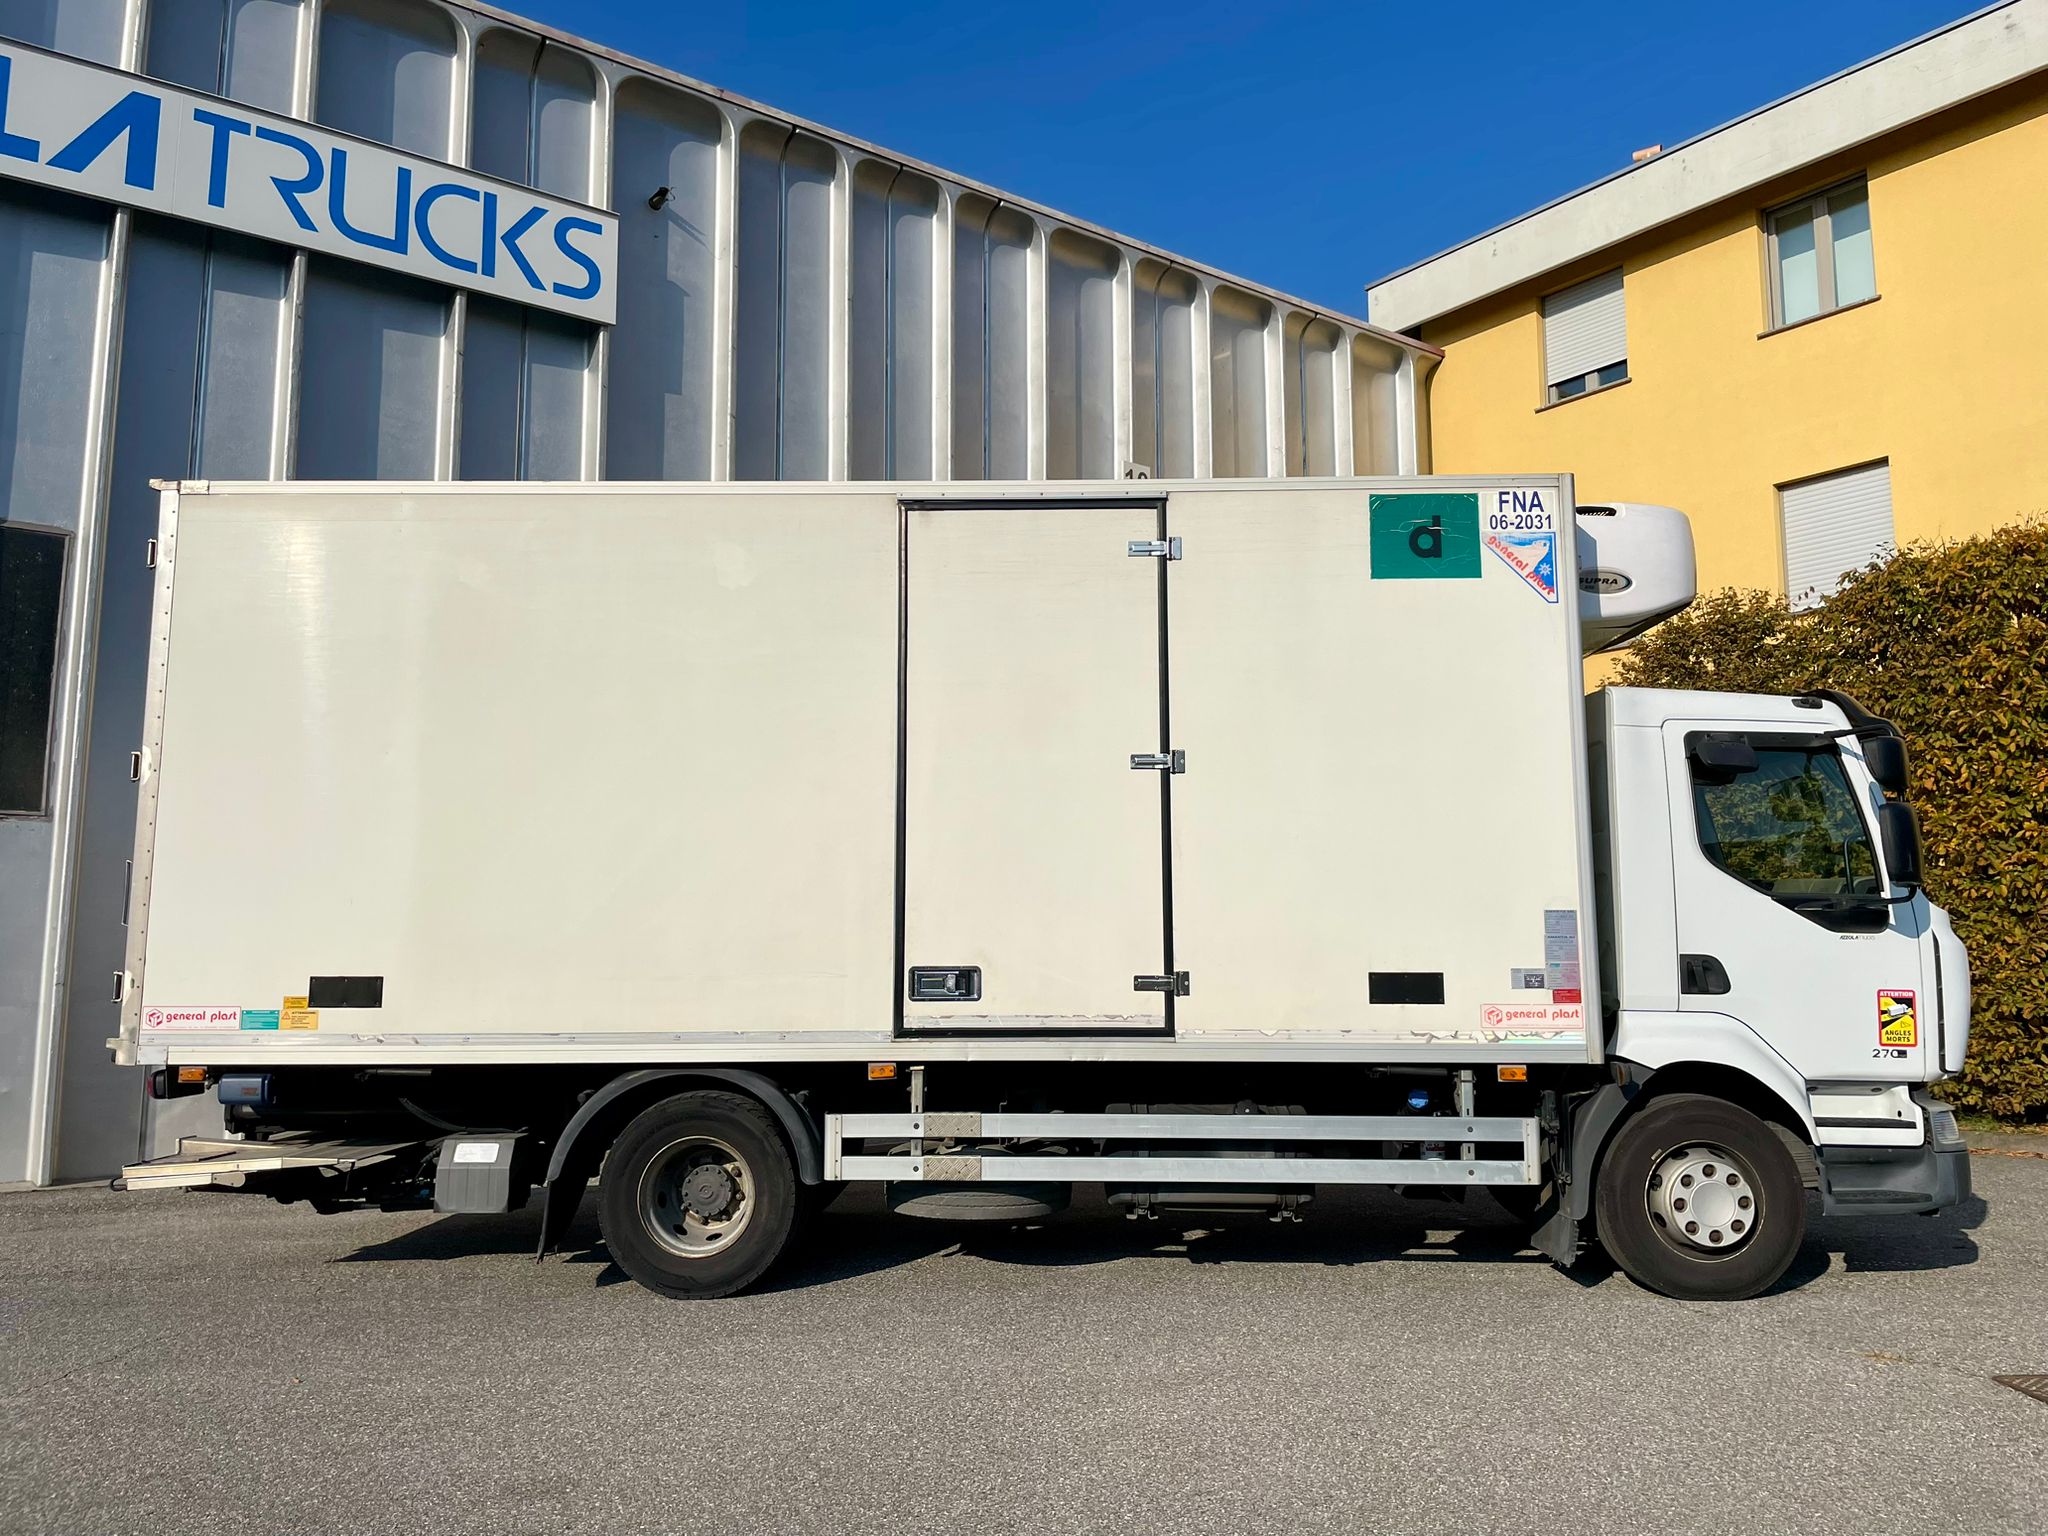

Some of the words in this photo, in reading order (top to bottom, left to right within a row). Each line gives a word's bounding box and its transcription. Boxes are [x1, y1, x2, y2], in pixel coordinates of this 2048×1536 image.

[194, 108, 602, 300] TRUCKS
[1498, 491, 1544, 512] FNA
[1489, 515, 1552, 529] 06-2031
[1409, 515, 1442, 558] d
[1487, 536, 1529, 571] general
[1525, 571, 1555, 595] plast
[166, 1011, 206, 1022] general
[210, 1011, 237, 1022] plast
[1505, 1009, 1547, 1021] general
[1552, 1009, 1579, 1021] plast
